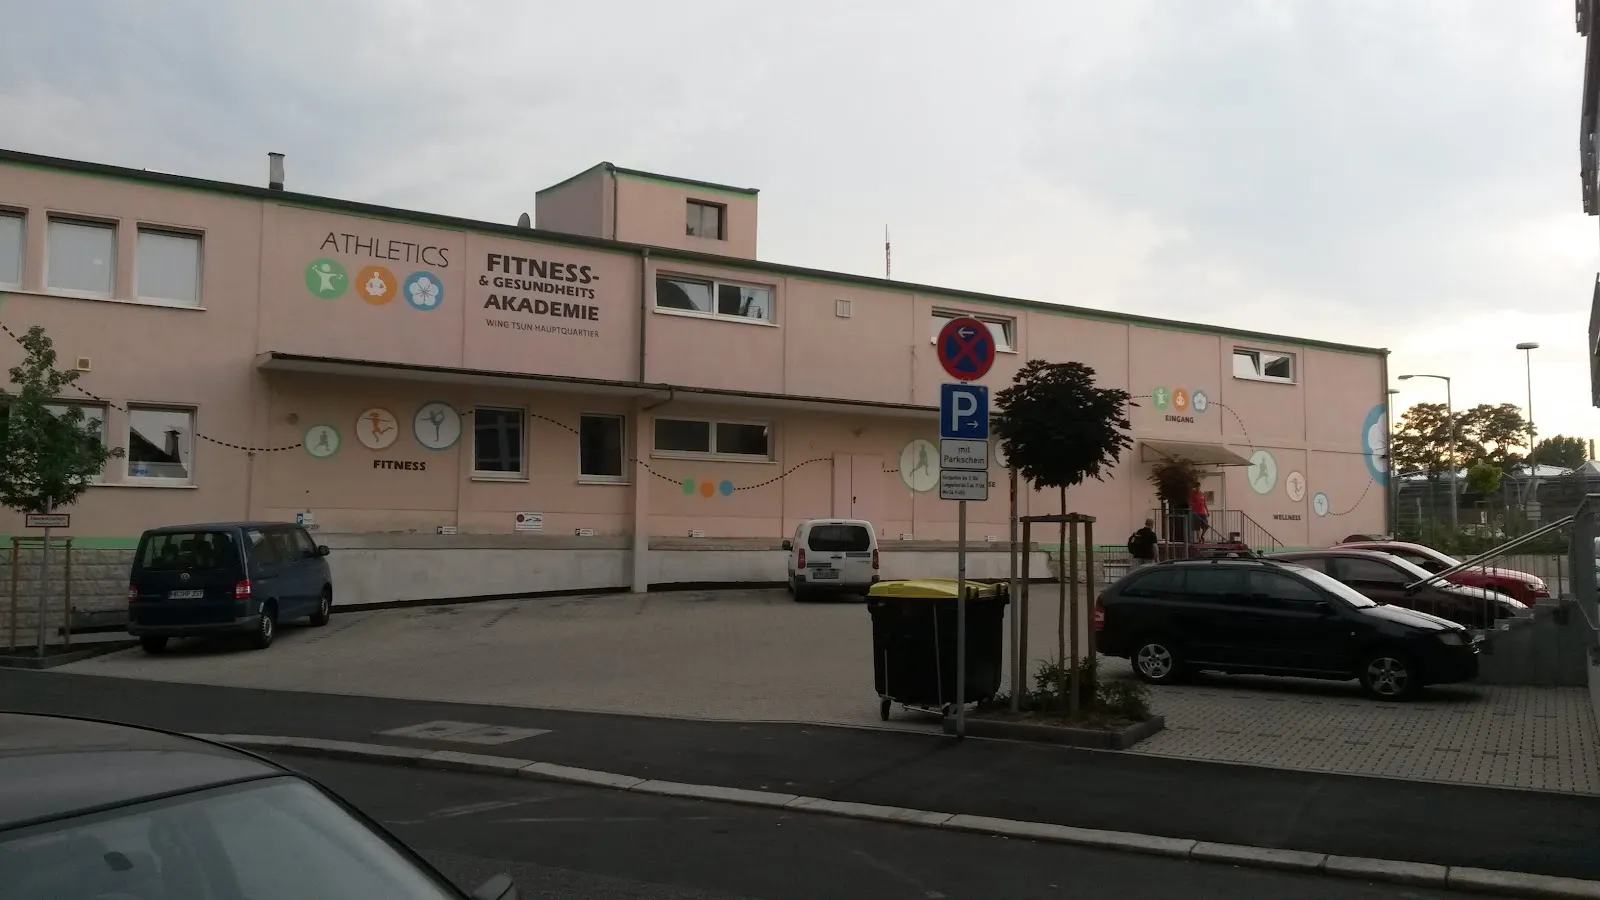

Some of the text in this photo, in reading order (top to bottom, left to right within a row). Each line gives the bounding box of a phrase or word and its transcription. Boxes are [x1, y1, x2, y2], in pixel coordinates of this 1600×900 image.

[320, 232, 449, 268] ATHLETICS
[487, 253, 600, 284] FITNESS-
[479, 275, 595, 299] & GESUNDHEITS
[483, 294, 599, 321] AKADEMIE
[485, 319, 599, 338] WING TSUN HAUPTQUARTIER
[952, 391, 978, 431] P
[1165, 414, 1194, 423] EINGANG
[373, 460, 426, 471] FITNESS
[944, 455, 985, 464] Parkschein
